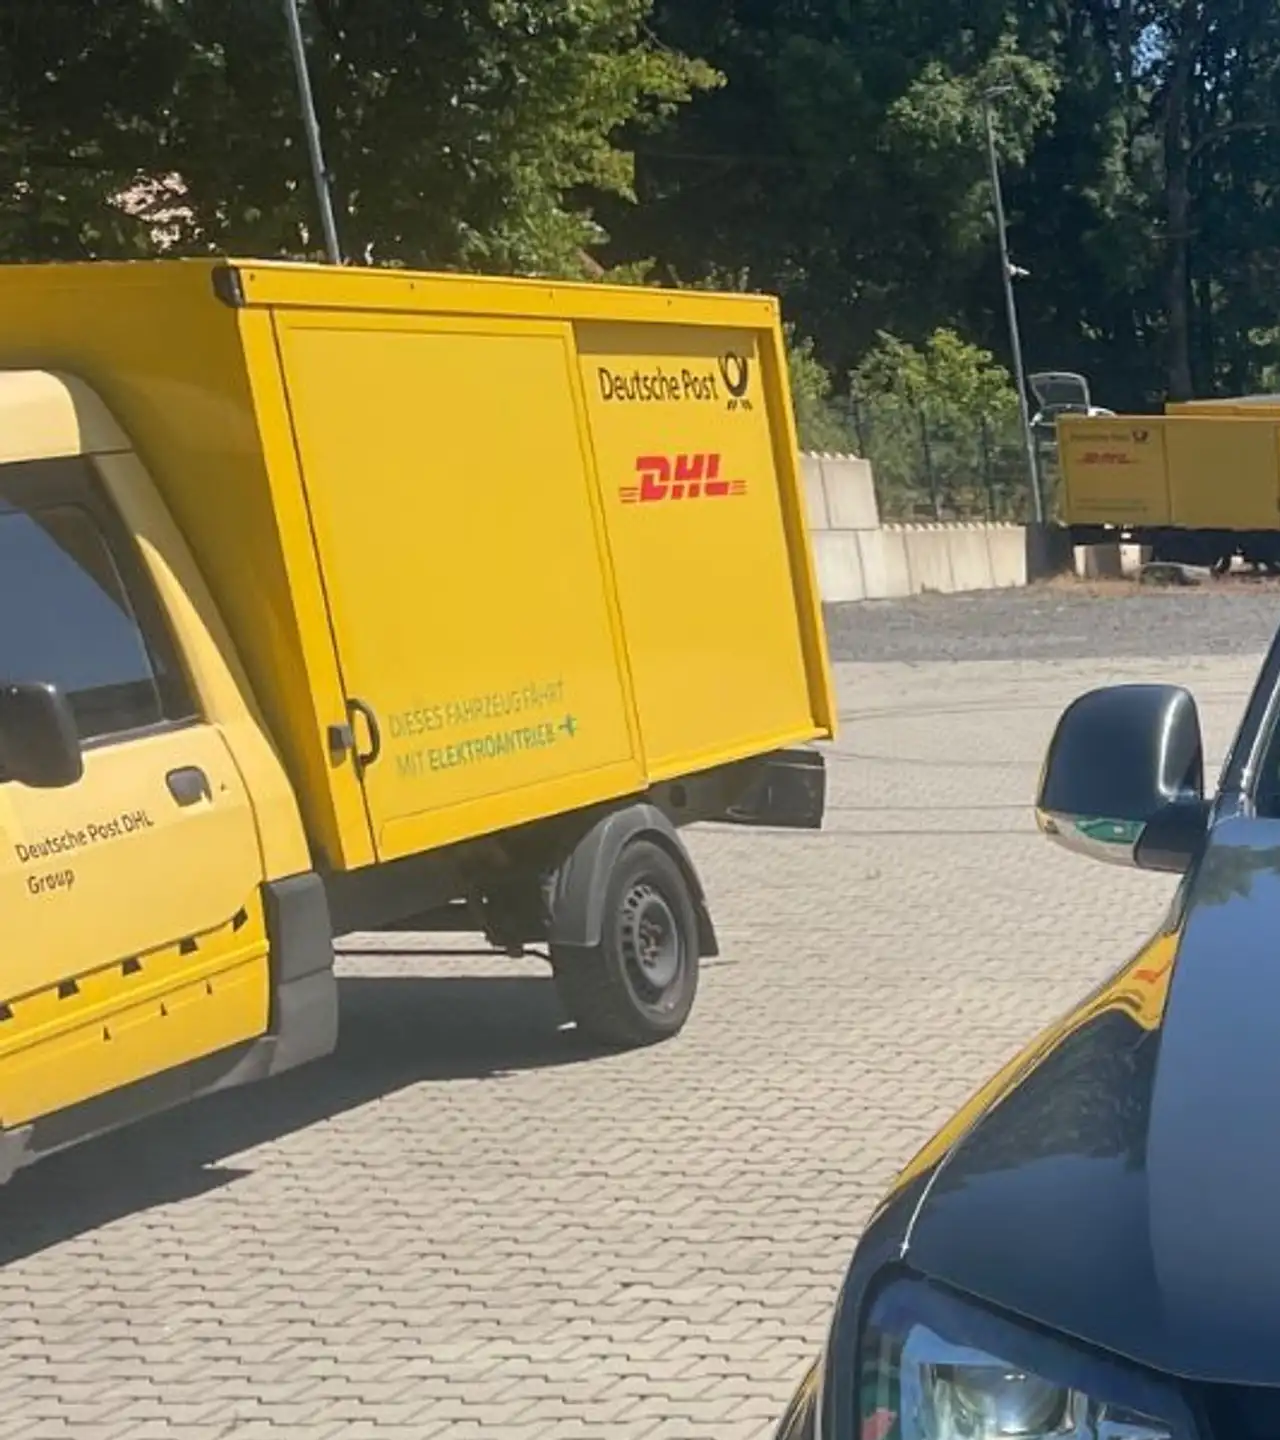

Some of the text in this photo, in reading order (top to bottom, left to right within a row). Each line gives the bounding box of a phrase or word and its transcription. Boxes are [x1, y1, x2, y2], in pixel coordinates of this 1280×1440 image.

[598, 366, 719, 401] Deutsche Post
[634, 453, 731, 503] DHL
[15, 810, 155, 863] Deutsche Post DHL
[27, 868, 76, 895] Group
